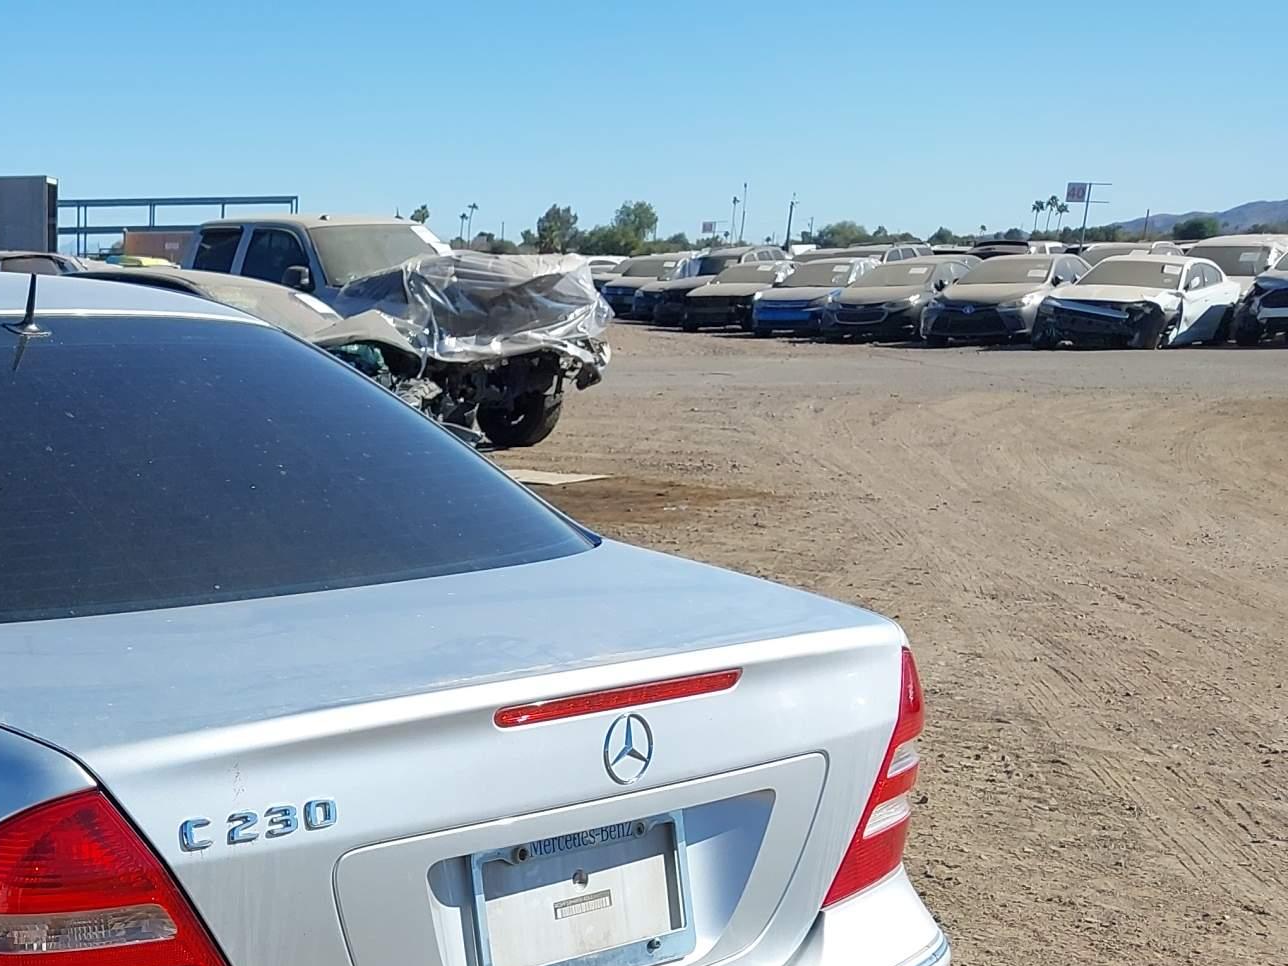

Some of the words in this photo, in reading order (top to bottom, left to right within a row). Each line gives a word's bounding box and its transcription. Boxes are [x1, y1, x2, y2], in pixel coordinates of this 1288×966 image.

[179, 818, 213, 853] C
[226, 799, 338, 846] 230
[530, 821, 634, 858] Mercedes-Benz
